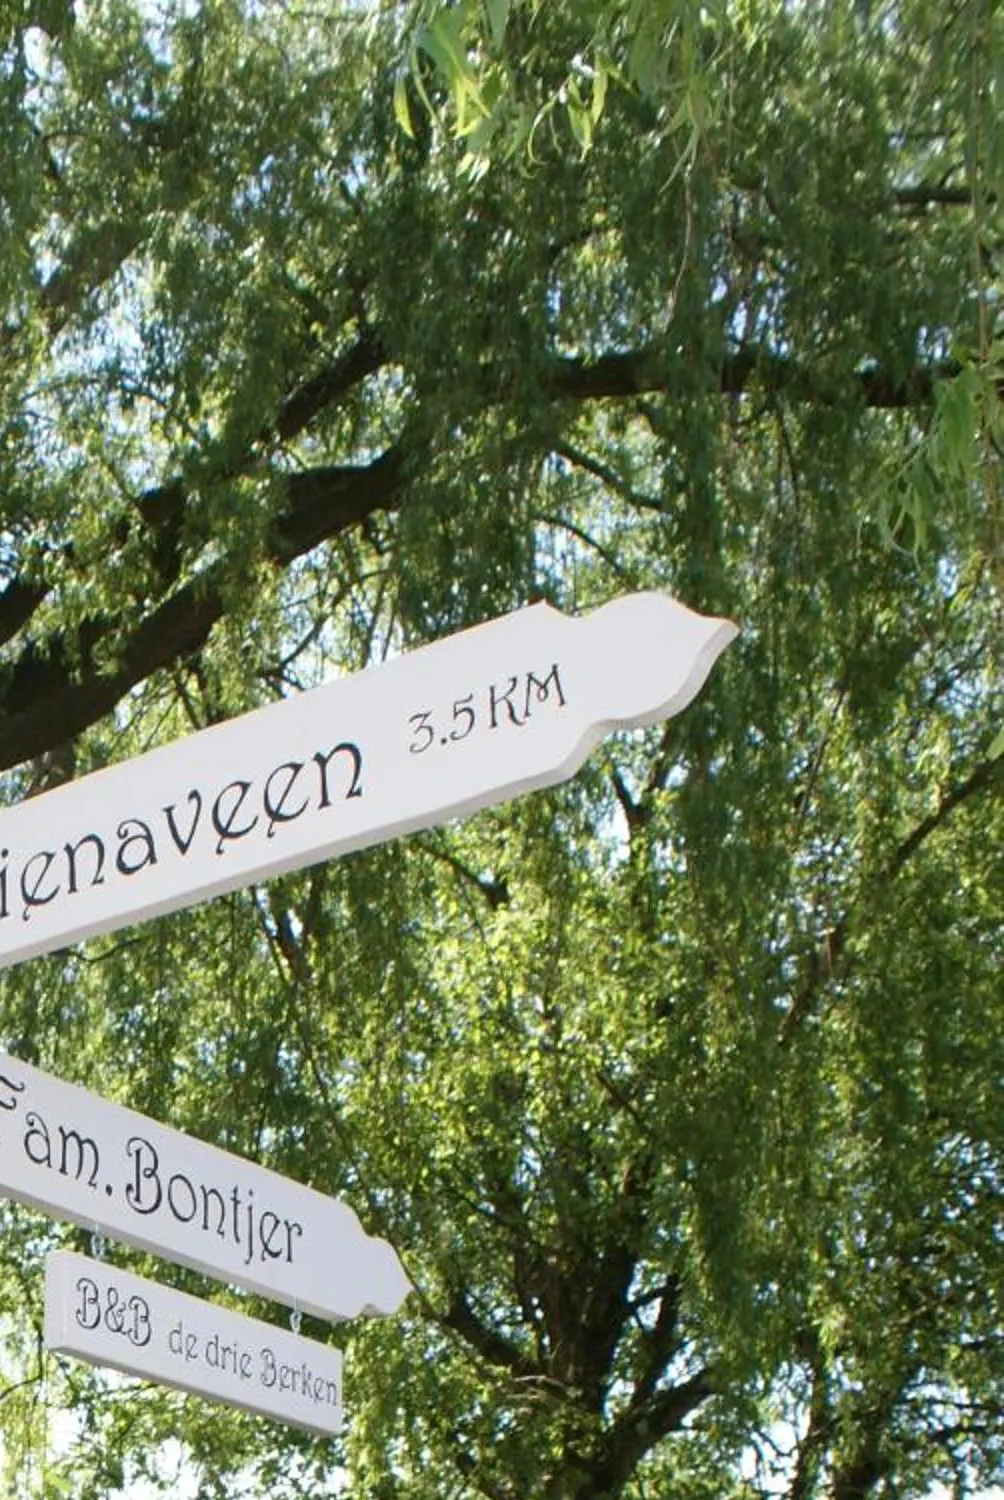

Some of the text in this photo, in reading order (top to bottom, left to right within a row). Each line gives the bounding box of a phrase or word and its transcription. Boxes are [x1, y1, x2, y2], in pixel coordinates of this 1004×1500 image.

[76, 1278, 338, 1407] B&B de drie Berken
